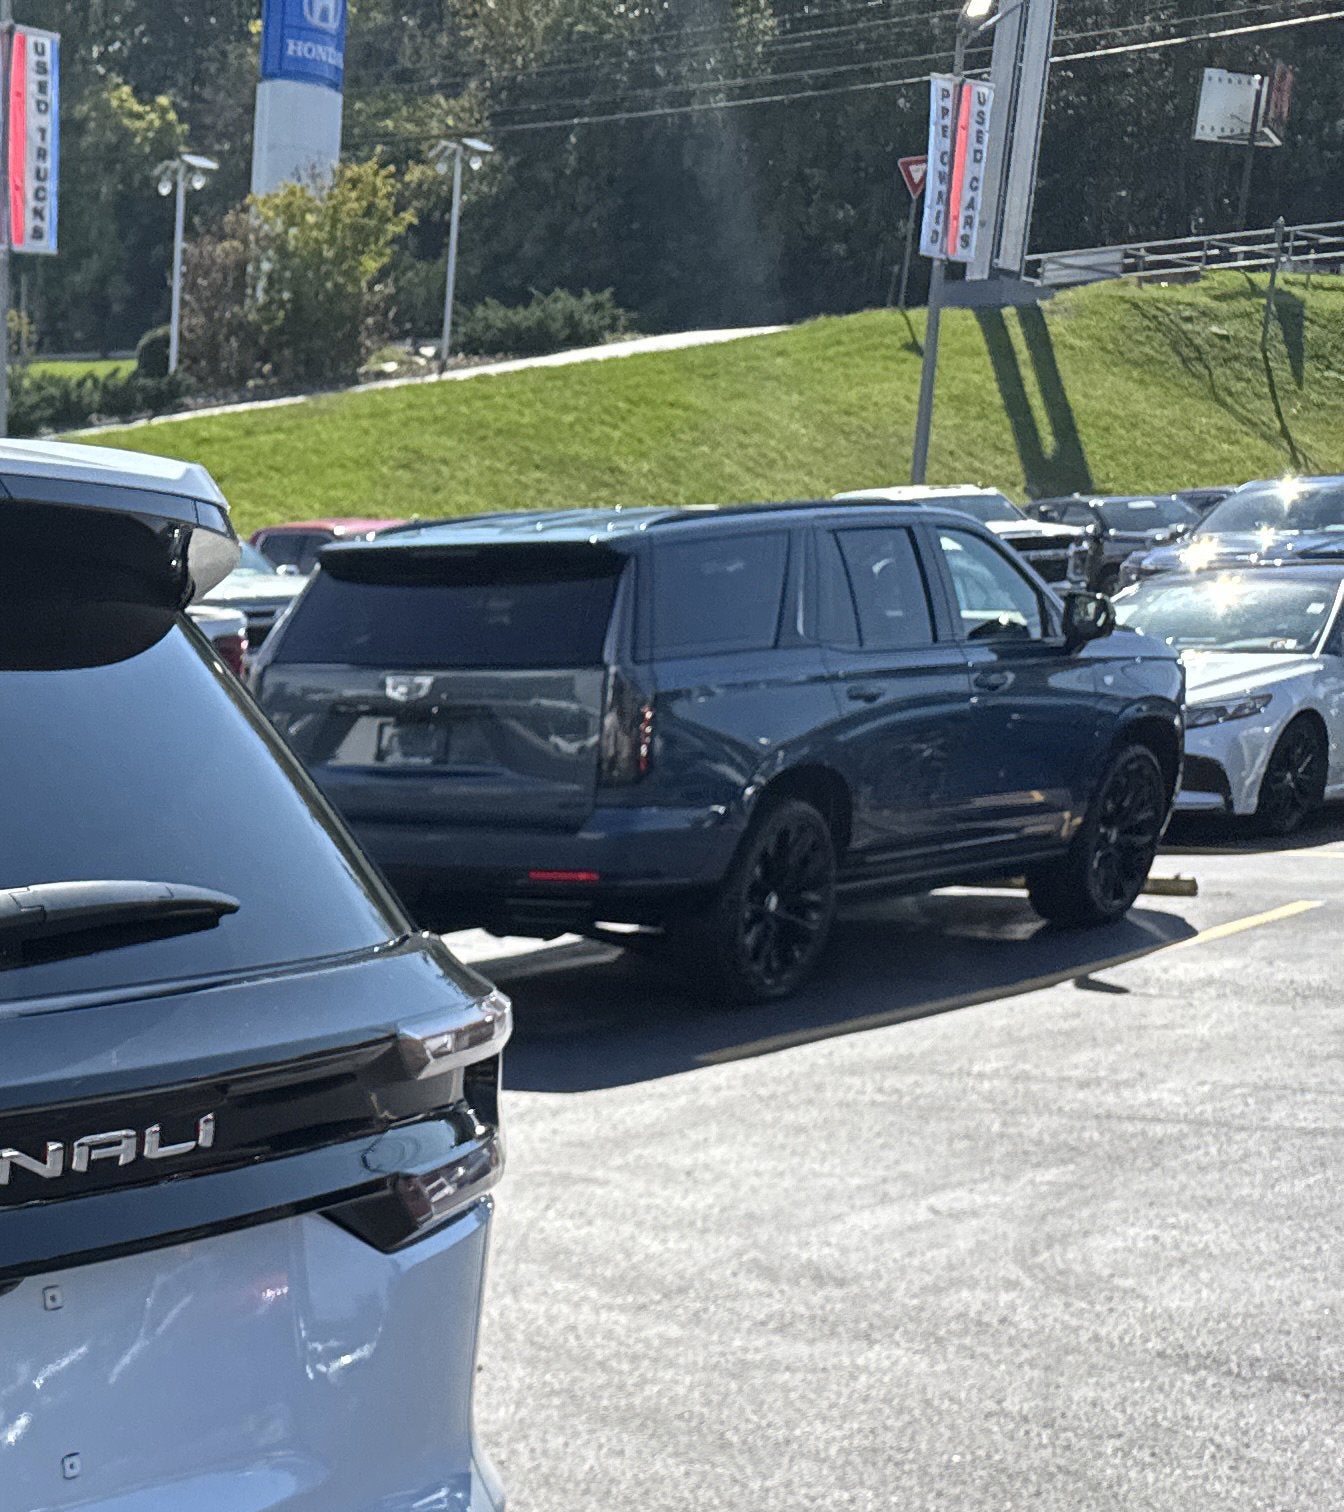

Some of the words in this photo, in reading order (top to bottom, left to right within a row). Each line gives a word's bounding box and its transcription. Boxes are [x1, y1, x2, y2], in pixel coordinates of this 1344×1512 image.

[33, 40, 50, 115] USED
[972, 91, 987, 165] USED
[31, 127, 49, 241] TRUCKS
[959, 176, 980, 250] CARS
